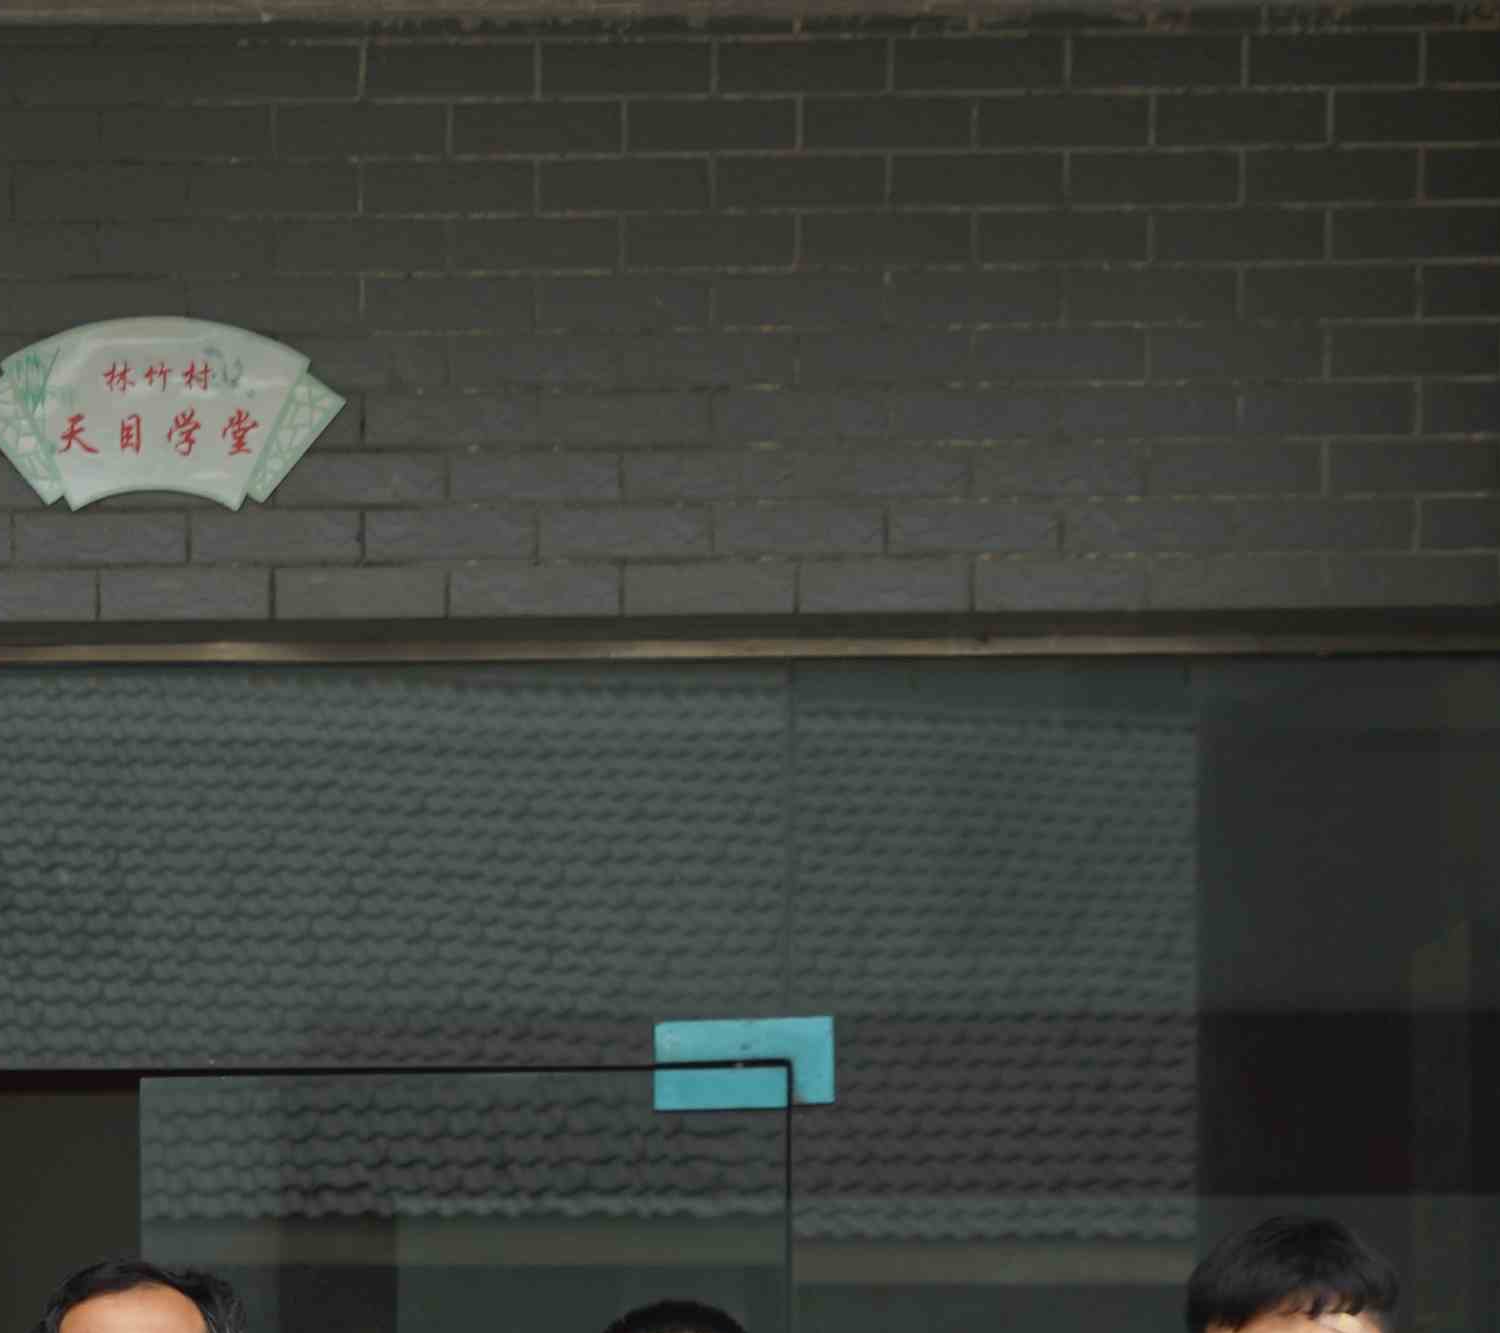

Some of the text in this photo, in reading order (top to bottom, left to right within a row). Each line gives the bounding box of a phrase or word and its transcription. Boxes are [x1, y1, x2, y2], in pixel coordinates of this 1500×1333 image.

[103, 360, 214, 391] 林竹村
[58, 407, 260, 456] 天目学堂
